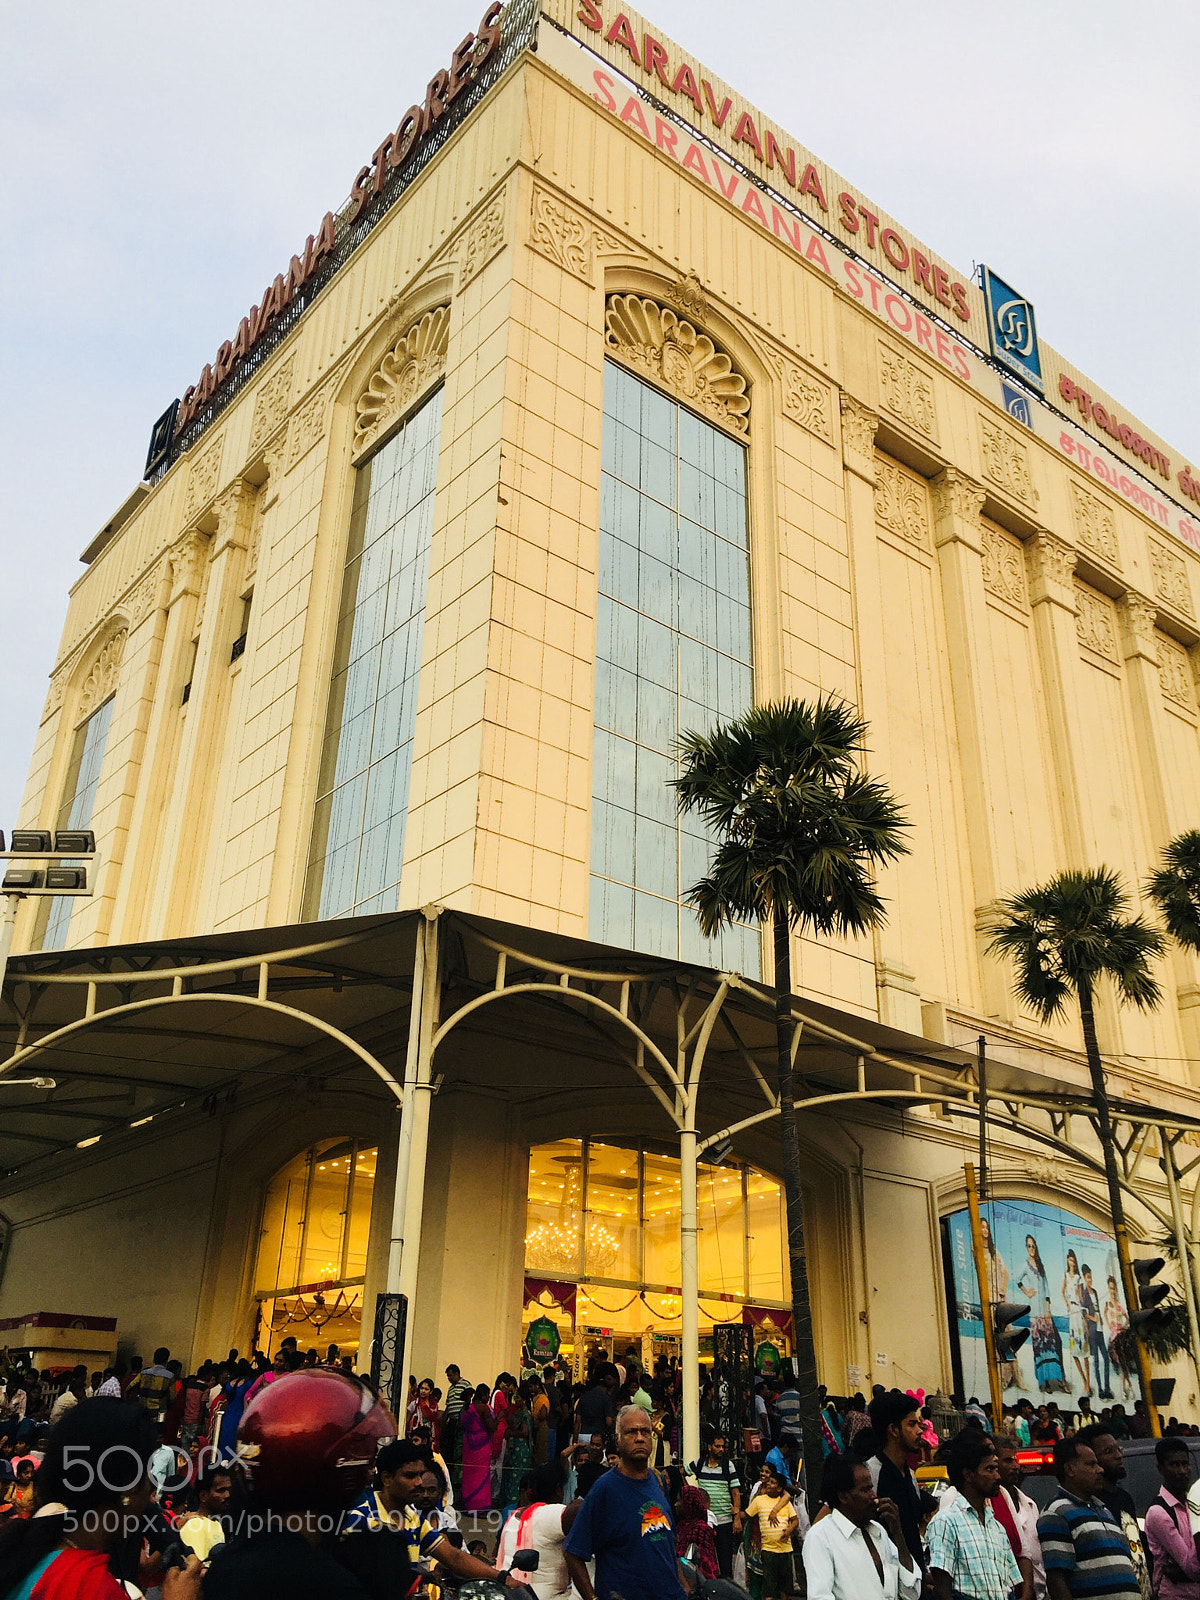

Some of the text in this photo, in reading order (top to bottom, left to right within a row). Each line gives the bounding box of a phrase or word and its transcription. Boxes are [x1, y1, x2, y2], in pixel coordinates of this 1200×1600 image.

[174, 1, 502, 438] SARAVANA STORES
[577, 0, 971, 321] SARAVANA STORES
[592, 70, 971, 381] SARAVANA STORES
[996, 345, 1044, 390] Super Store
[1059, 373, 1171, 481] சரவணா
[1059, 431, 1170, 526] சரவணா
